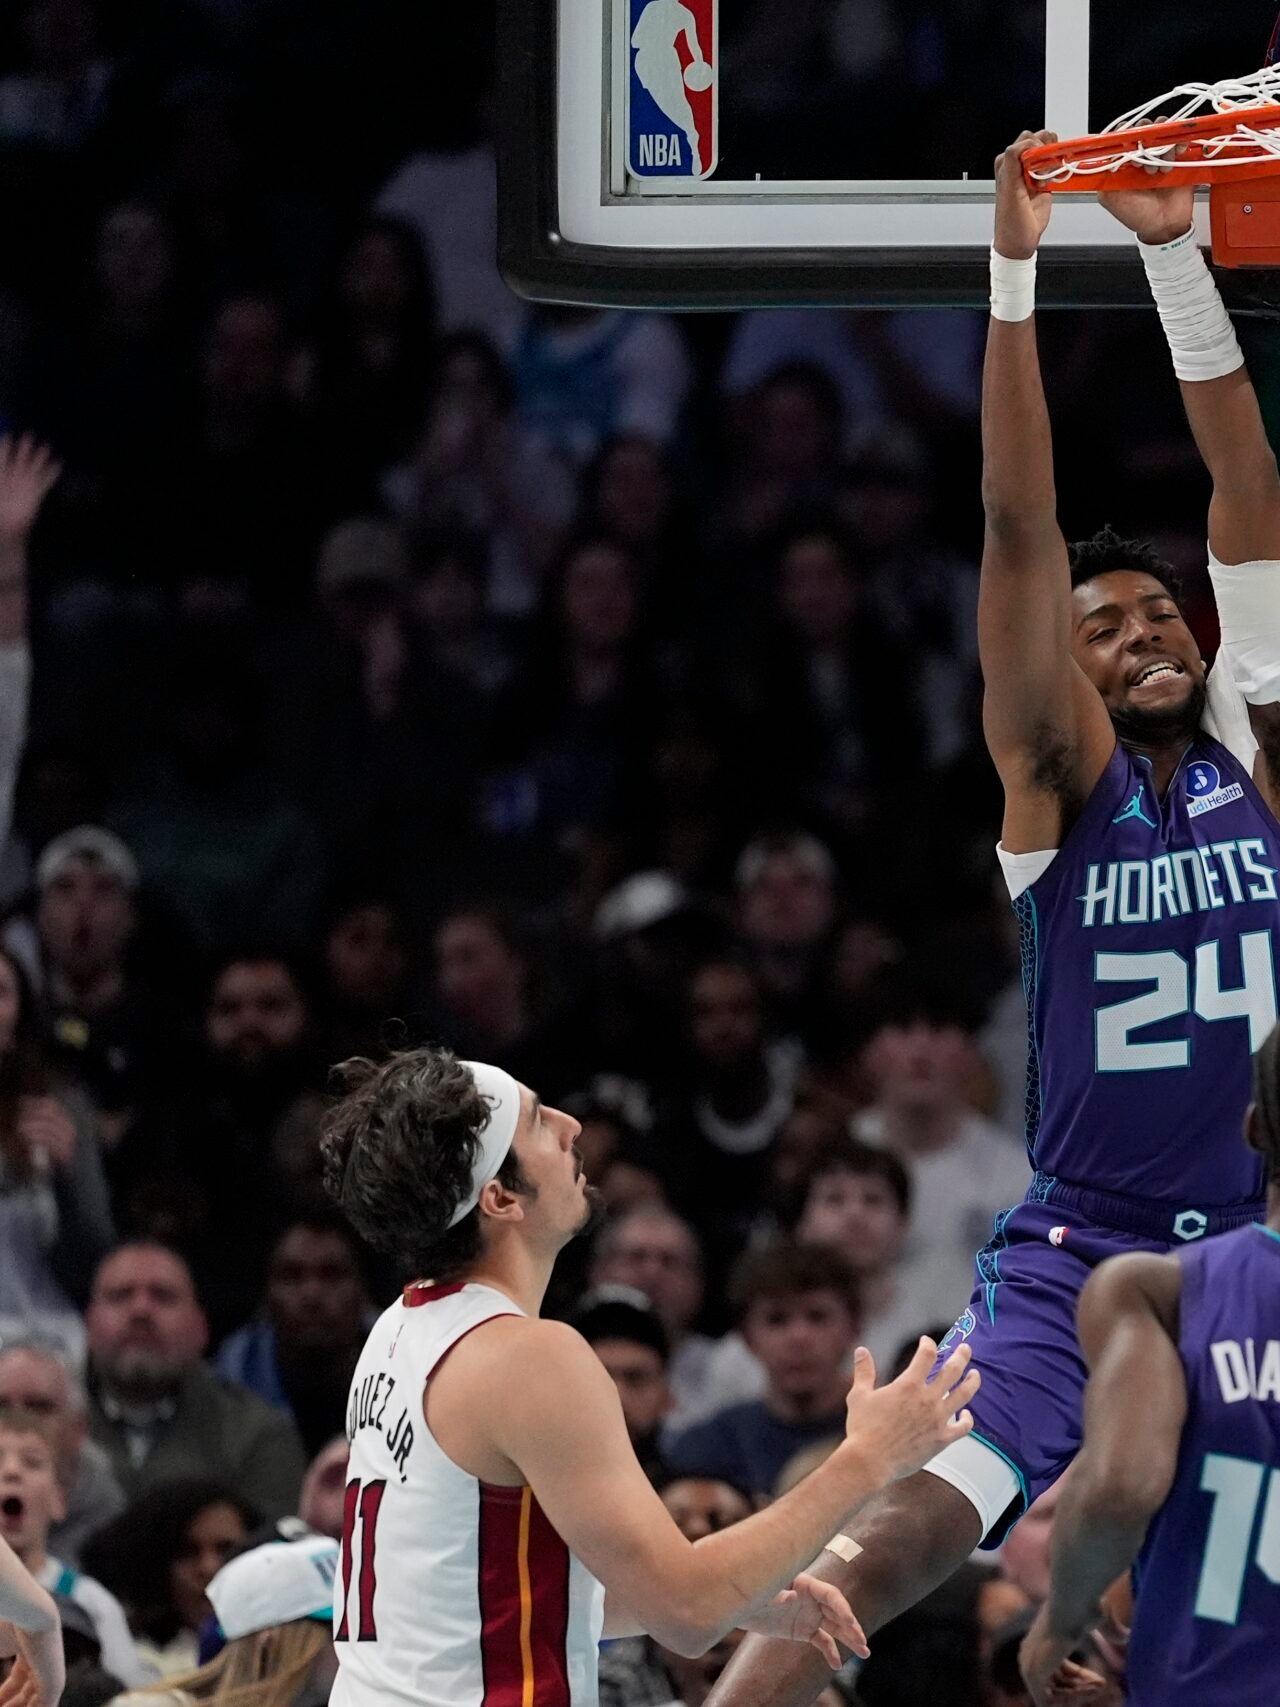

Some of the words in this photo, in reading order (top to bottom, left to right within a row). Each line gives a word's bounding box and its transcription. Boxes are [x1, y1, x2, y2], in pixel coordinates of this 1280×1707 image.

[639, 133, 682, 167] NBA
[1189, 799, 1209, 815] udi
[1207, 785, 1242, 808] Health
[1075, 838, 1279, 927] HORNETS
[1094, 928, 1278, 1073] 24
[349, 1372, 396, 1440] QUEZ
[386, 1407, 415, 1484] JR.
[334, 1477, 388, 1642] 11
